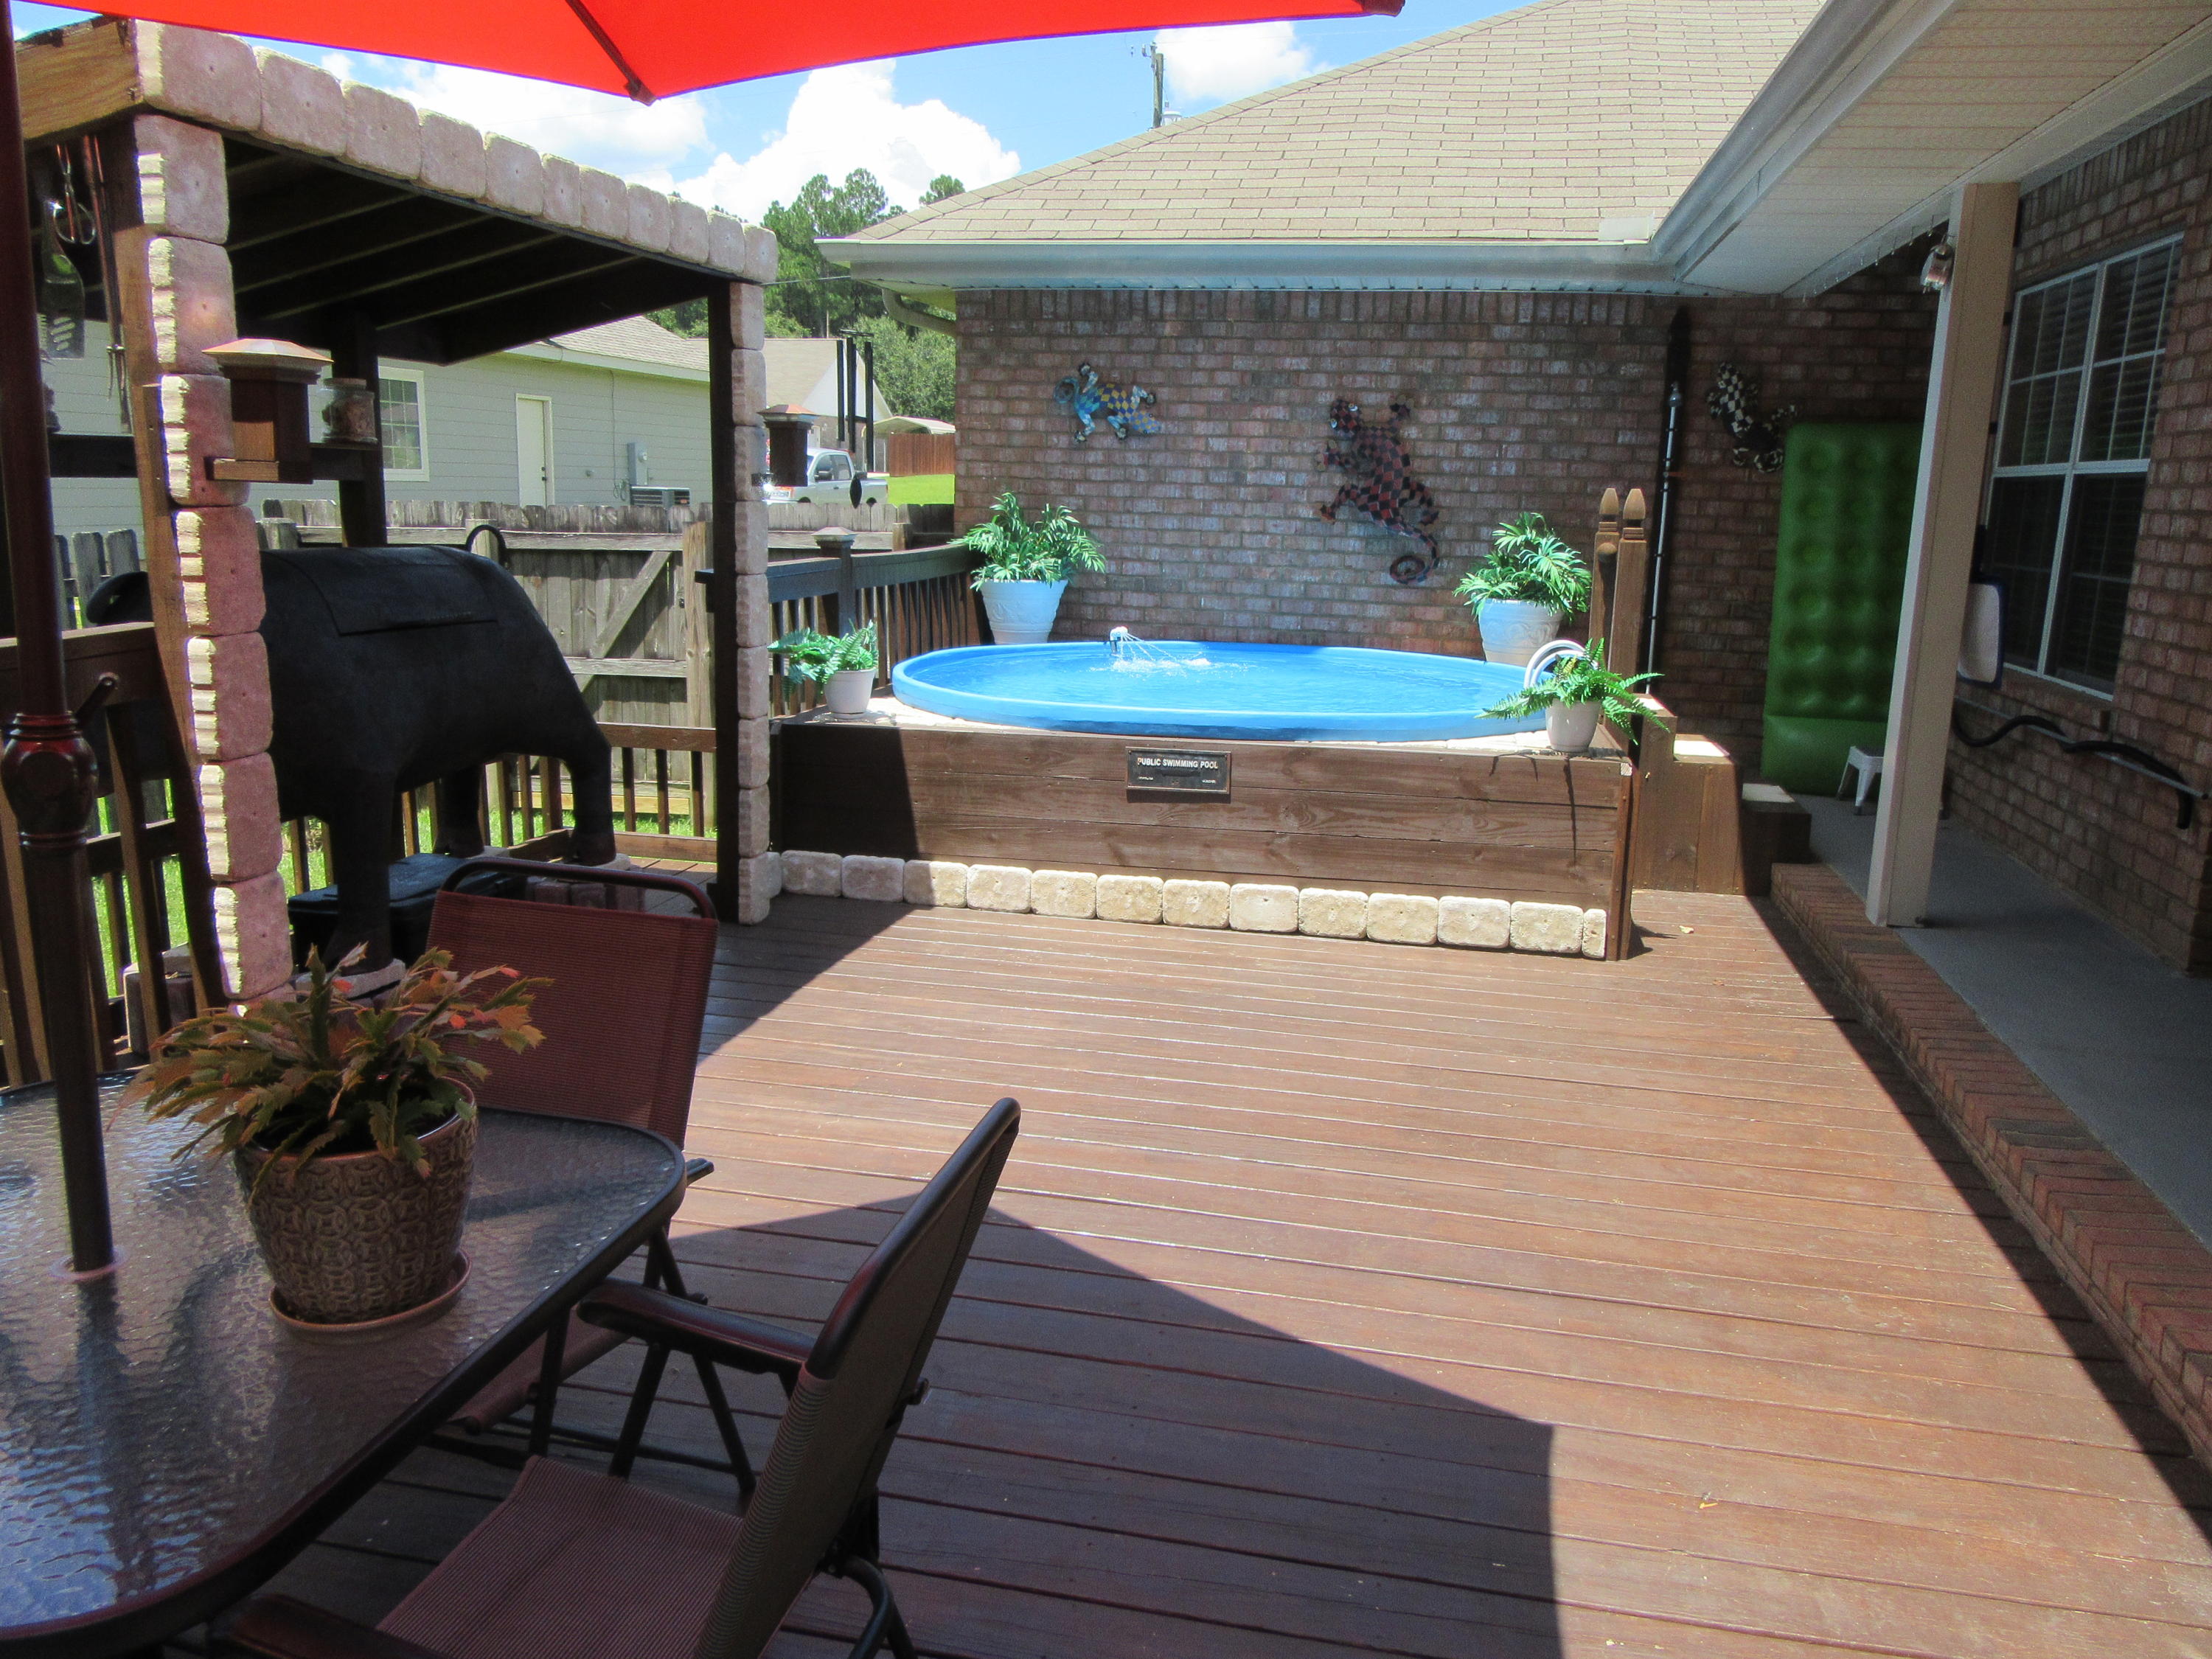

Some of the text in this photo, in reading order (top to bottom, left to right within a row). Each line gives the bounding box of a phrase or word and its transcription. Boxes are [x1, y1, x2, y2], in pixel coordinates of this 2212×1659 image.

[1138, 757, 1218, 769] PUBLIC SWIMMING POOL
